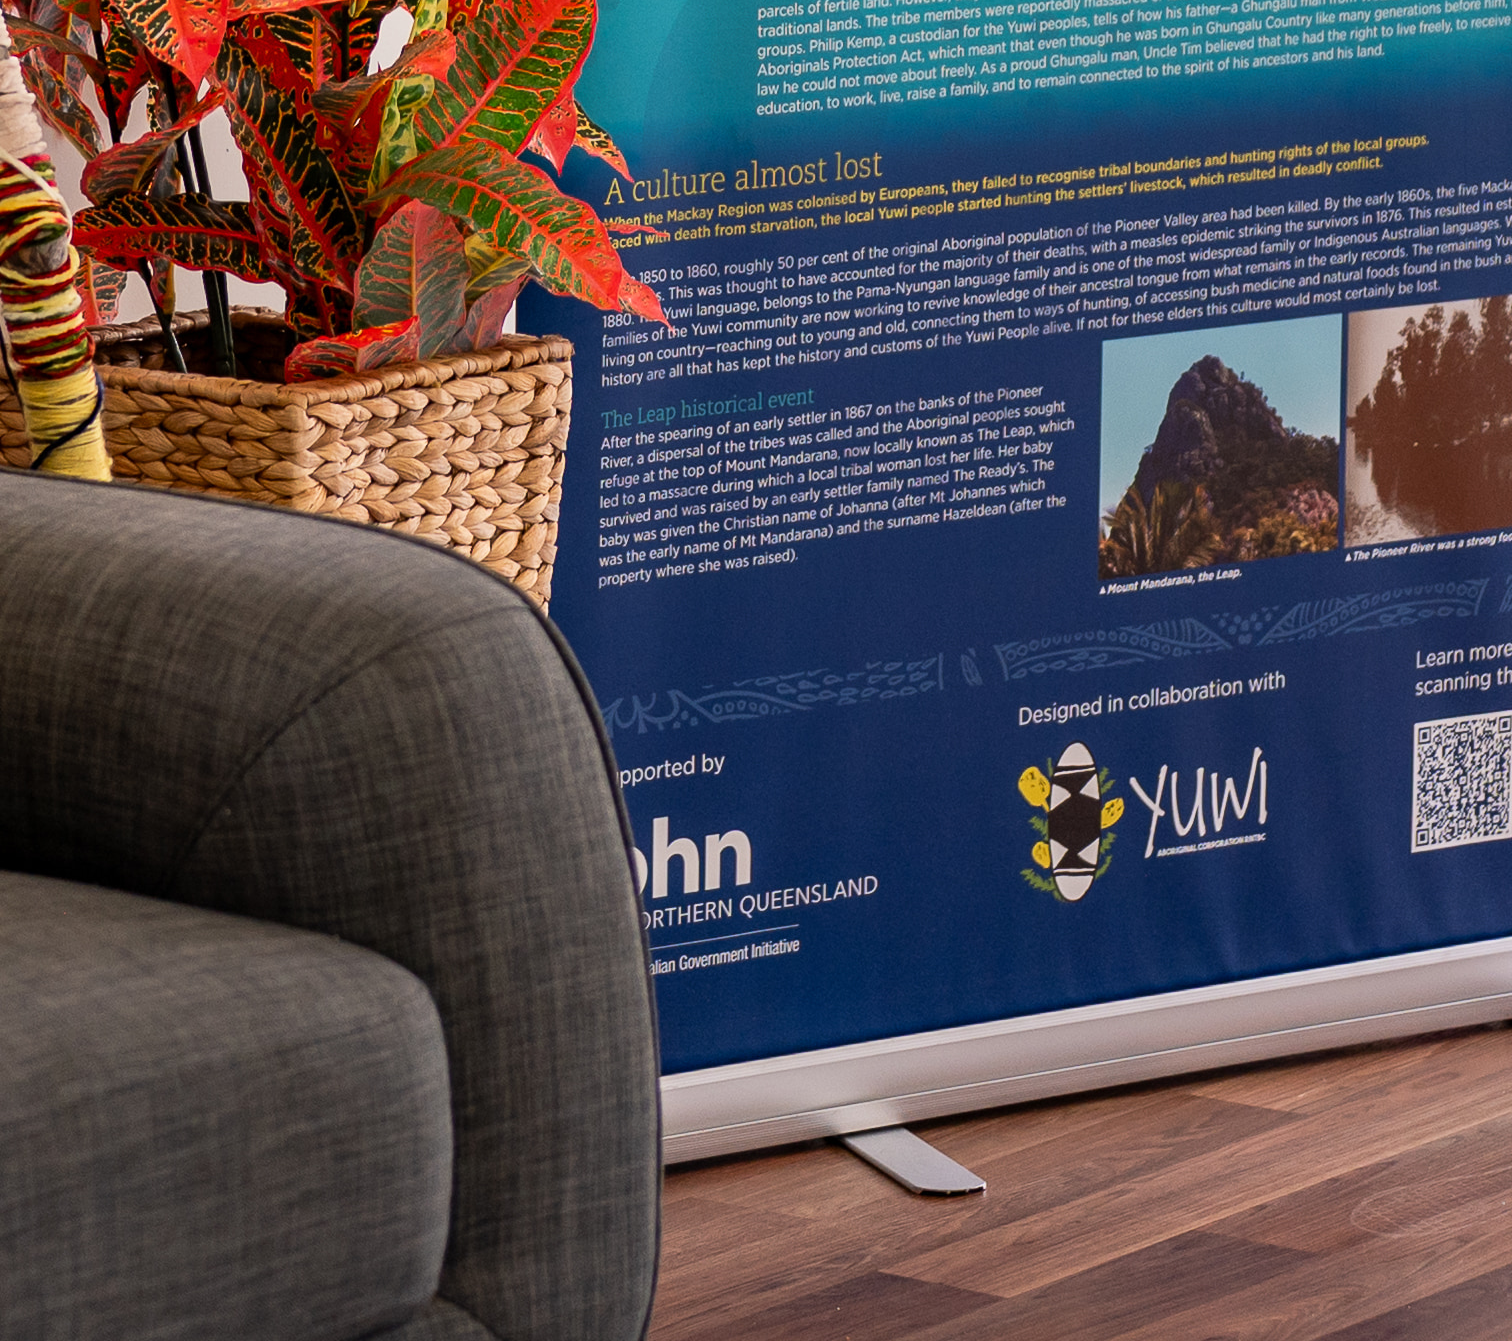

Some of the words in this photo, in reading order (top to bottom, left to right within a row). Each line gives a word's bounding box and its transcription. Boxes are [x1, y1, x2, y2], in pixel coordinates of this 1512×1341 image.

[604, 178, 626, 207] A
[632, 167, 726, 203] culture
[734, 158, 829, 193] almost
[834, 151, 884, 182] lost
[601, 409, 633, 429] The
[636, 403, 677, 428] Leap
[680, 390, 764, 420] historical
[767, 388, 815, 409] event
[1415, 648, 1464, 669] Learn
[1018, 694, 1102, 726] Designed
[1107, 693, 1123, 713] in
[1127, 678, 1243, 710] collaboration
[1247, 669, 1286, 693] with
[1414, 670, 1491, 696] scanning
[701, 753, 726, 774] by
[1128, 745, 1268, 859] YUWI
[739, 874, 879, 919] QUEENSLAND
[679, 945, 749, 971] Government
[751, 938, 800, 960] Initiative
